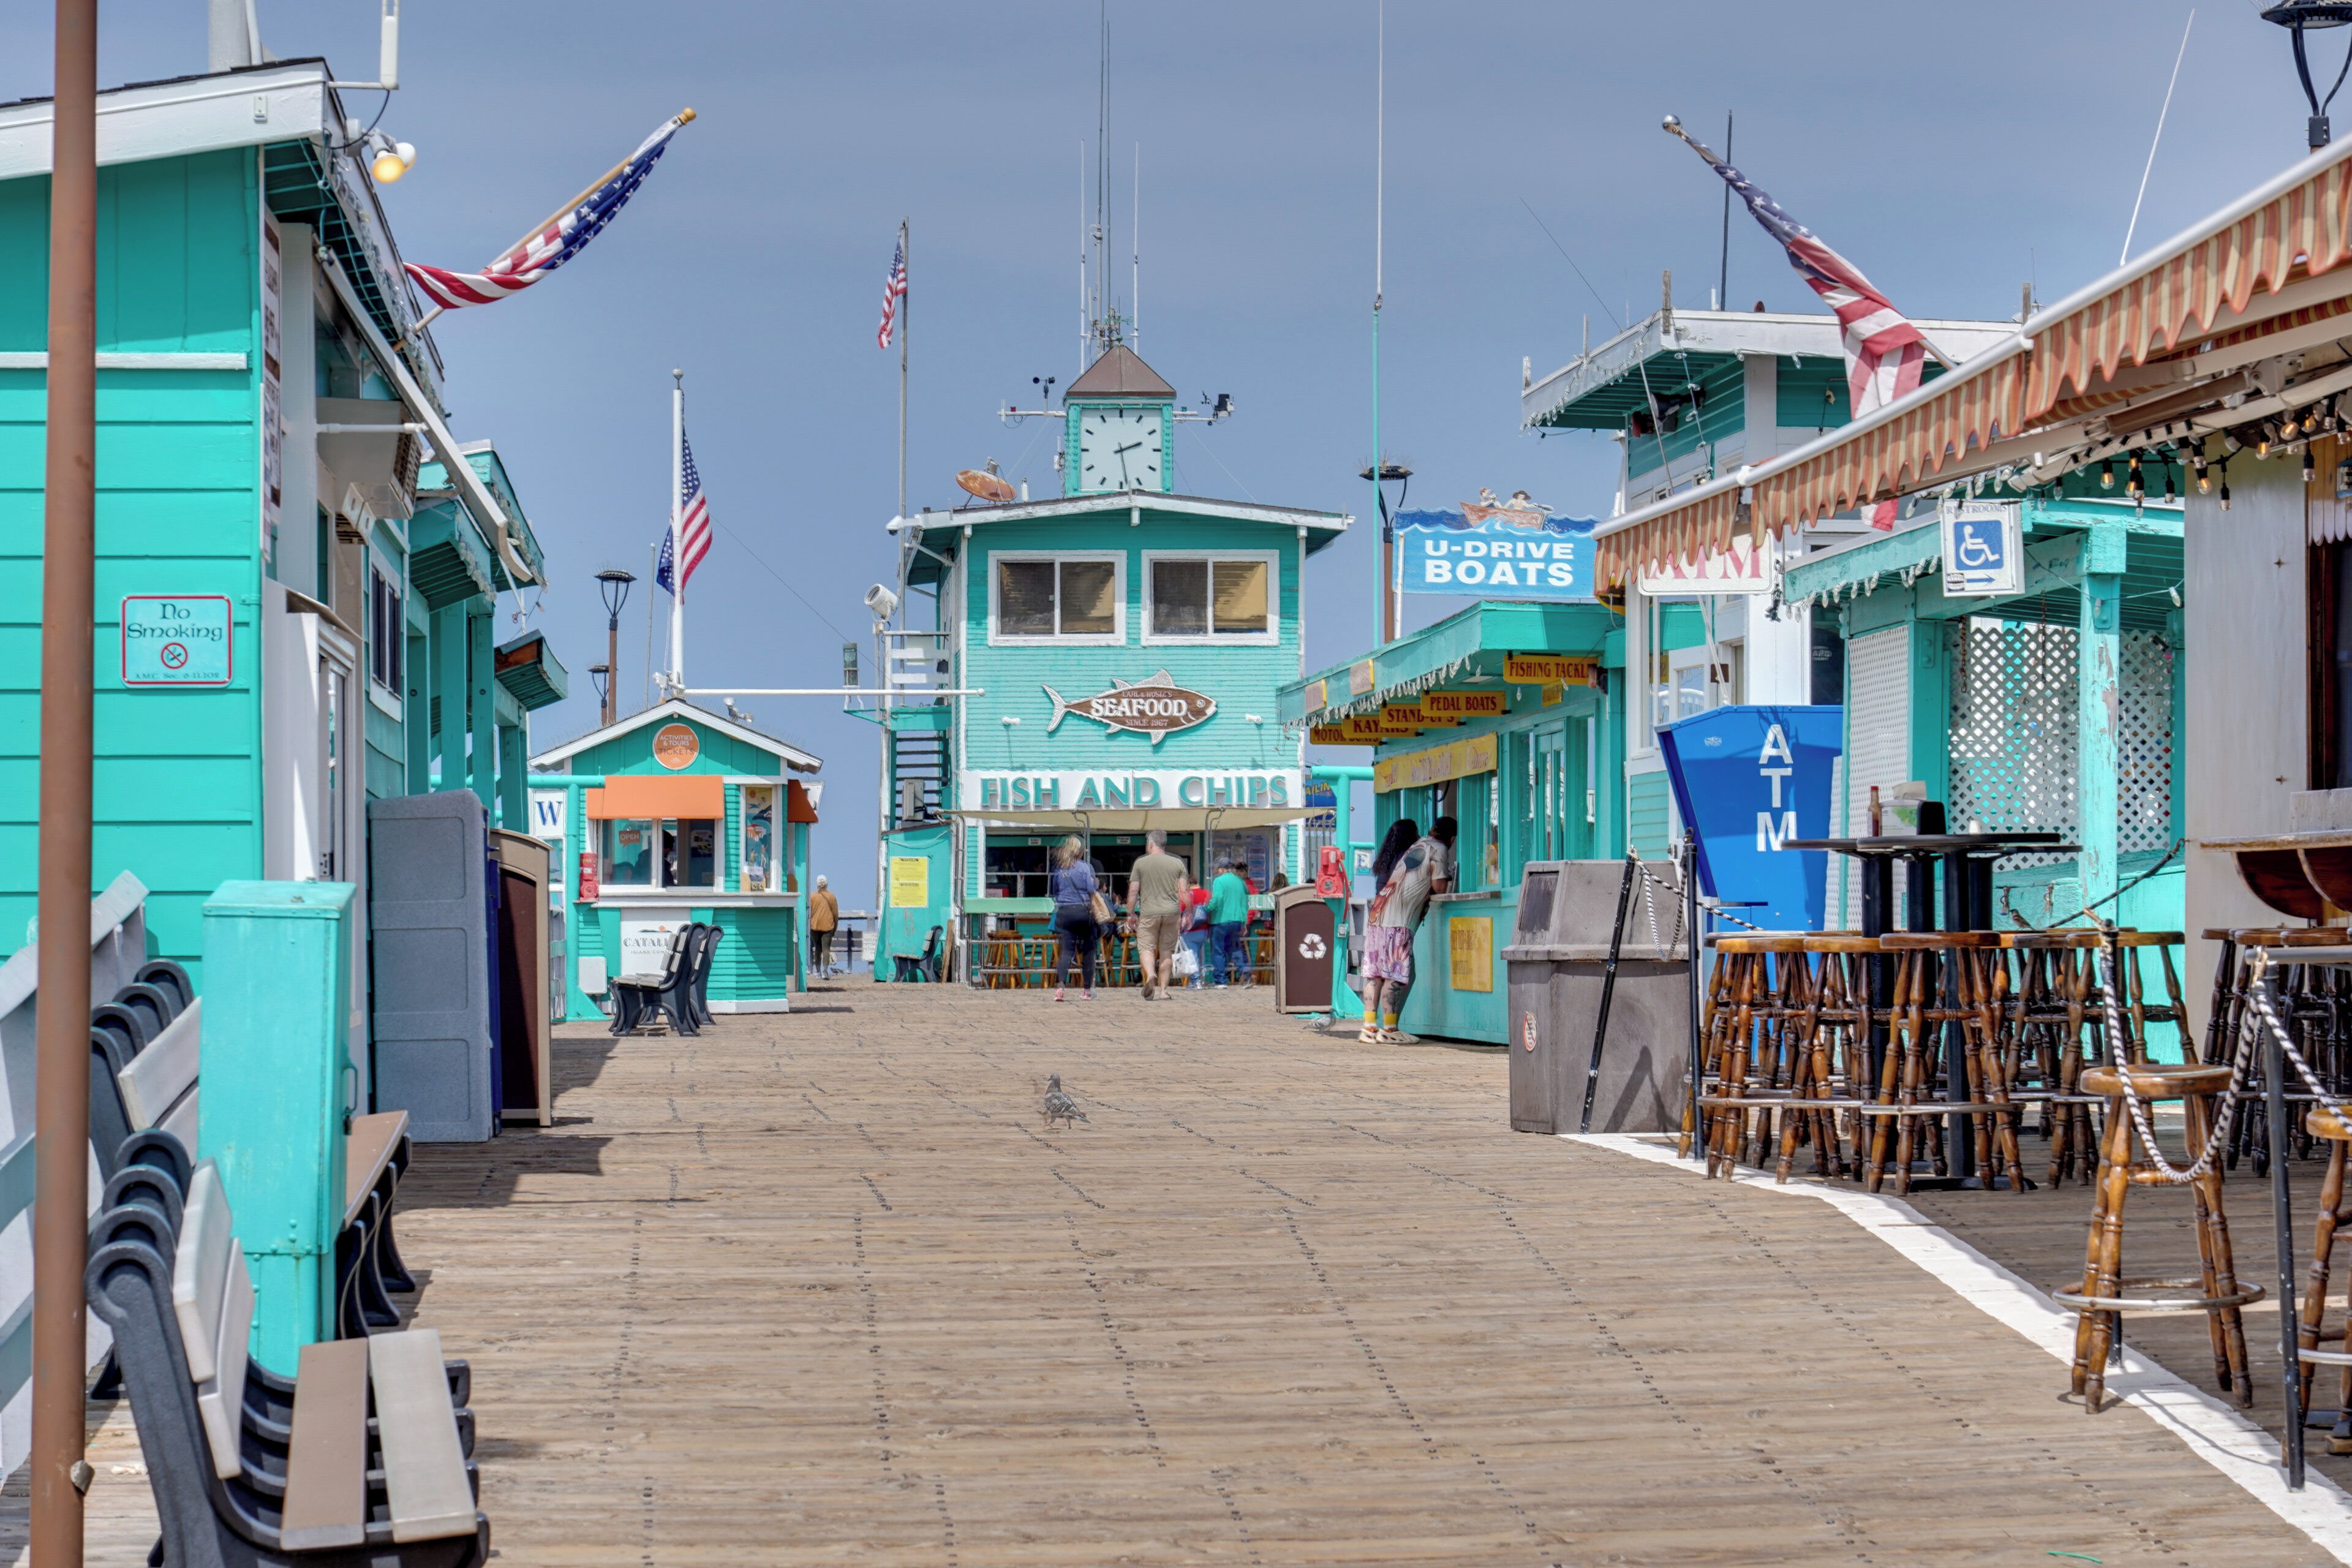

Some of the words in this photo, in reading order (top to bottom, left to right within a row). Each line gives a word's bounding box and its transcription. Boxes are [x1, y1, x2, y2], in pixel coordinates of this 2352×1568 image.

[1425, 540, 1574, 559] U-DRIVE
[1425, 559, 1574, 586] BOATS
[160, 602, 190, 620] No
[127, 622, 223, 642] Smoking
[1509, 662, 1551, 677] FISHING
[1090, 698, 1188, 717] SEAFOOD
[1430, 696, 1461, 711] PEDAL
[1465, 696, 1497, 711] BOATS
[980, 777, 1060, 807] FISH
[1076, 777, 1161, 807] AND
[1177, 775, 1288, 807] CHIPS
[1305, 782, 1330, 795] AILIN
[1757, 724, 1797, 852] ATM
[535, 801, 563, 826] W
[623, 937, 669, 948] CATALI
